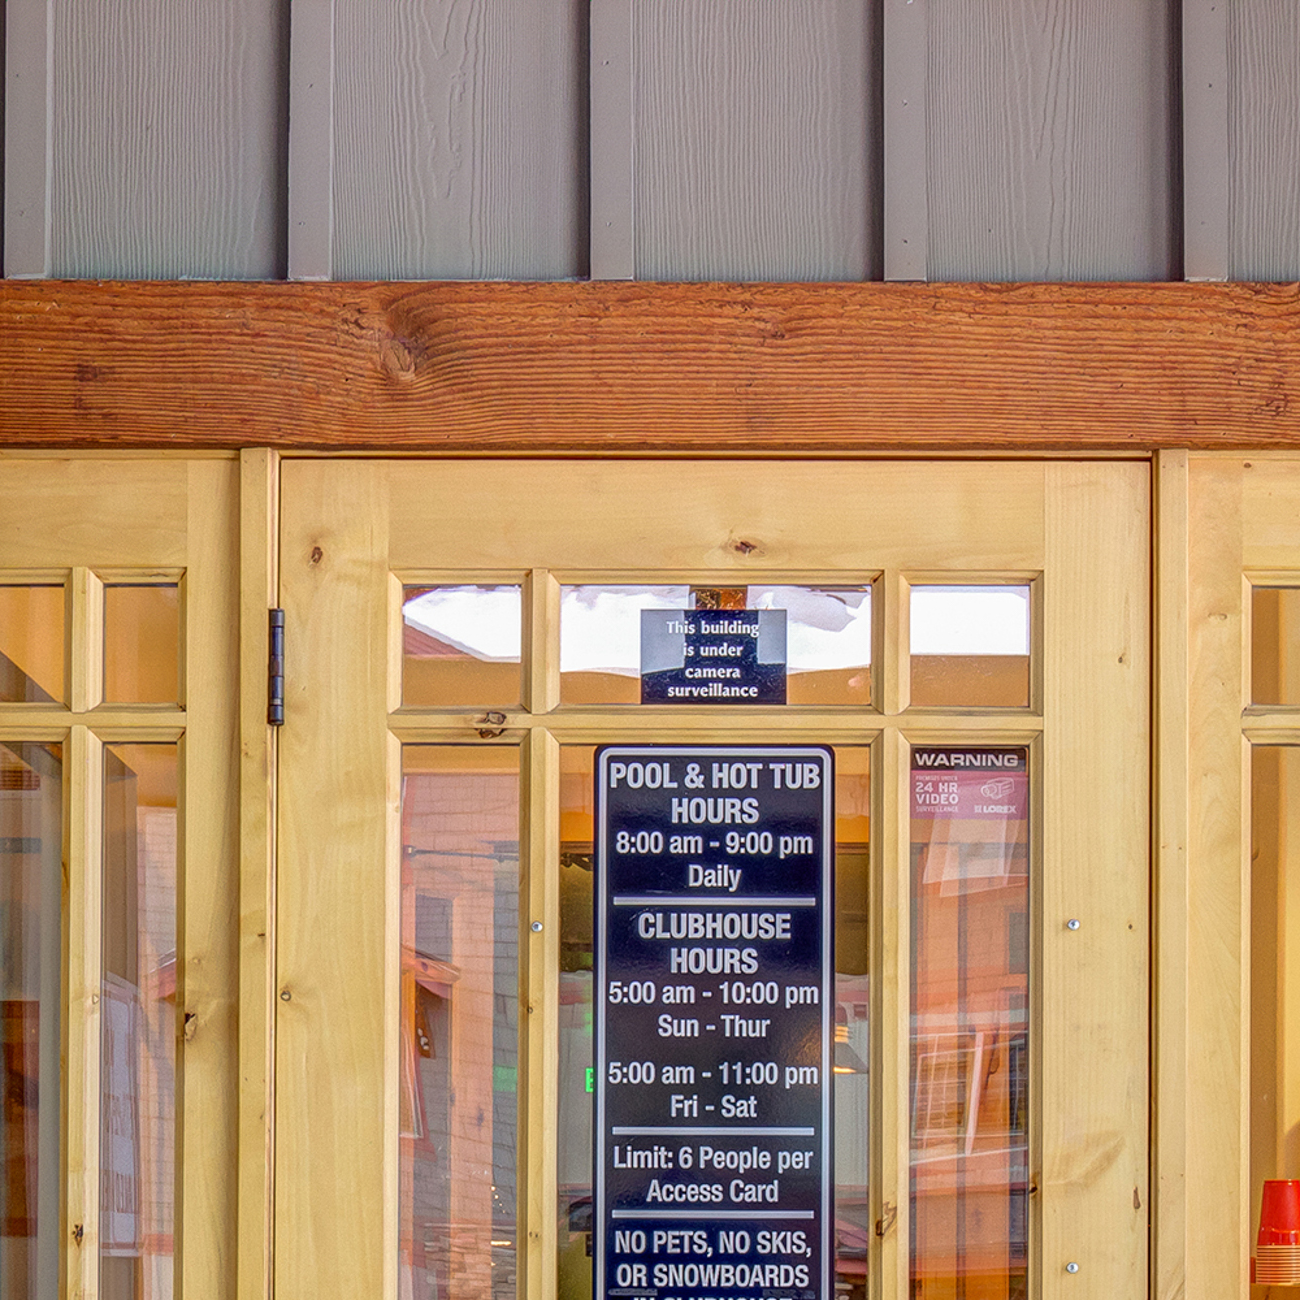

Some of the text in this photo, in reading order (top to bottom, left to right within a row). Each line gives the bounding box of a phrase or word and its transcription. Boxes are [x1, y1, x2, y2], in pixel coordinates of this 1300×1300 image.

[667, 621, 759, 637] This building
[683, 644, 743, 656] is under
[685, 668, 741, 678] camera
[668, 684, 758, 698] surveillance
[915, 754, 1018, 766] WARNING
[610, 762, 820, 789] POOL & HOT TUB
[916, 782, 958, 792] 24 HR
[916, 794, 958, 804] VIDEO
[983, 805, 1017, 813] LOREX
[671, 798, 759, 824] HOURS
[616, 832, 663, 854] 8:00
[670, 836, 702, 854] am
[726, 832, 772, 854] 9:00
[779, 836, 813, 858] pm
[688, 865, 741, 892] Daily
[638, 913, 791, 939] CLUBHOUSE
[671, 948, 758, 974] HOURS
[609, 982, 656, 1004] 5:00
[662, 986, 695, 1004] am
[719, 982, 779, 1004] 10:00
[785, 986, 819, 1008] pm
[658, 1015, 699, 1037] Sun
[720, 1015, 770, 1038] Thur
[608, 1062, 655, 1084] 5:00
[662, 1067, 694, 1084] am
[718, 1062, 779, 1084] 11:00
[785, 1067, 819, 1089] pm
[671, 1096, 698, 1118] Fri
[721, 1095, 757, 1118] Sat
[613, 1146, 813, 1173] Limit: 6 People per
[646, 1180, 779, 1202] Access Card
[615, 1230, 812, 1257] NO PETS, NO SKIS,
[617, 1264, 809, 1287] OR SNOWBOARDS
